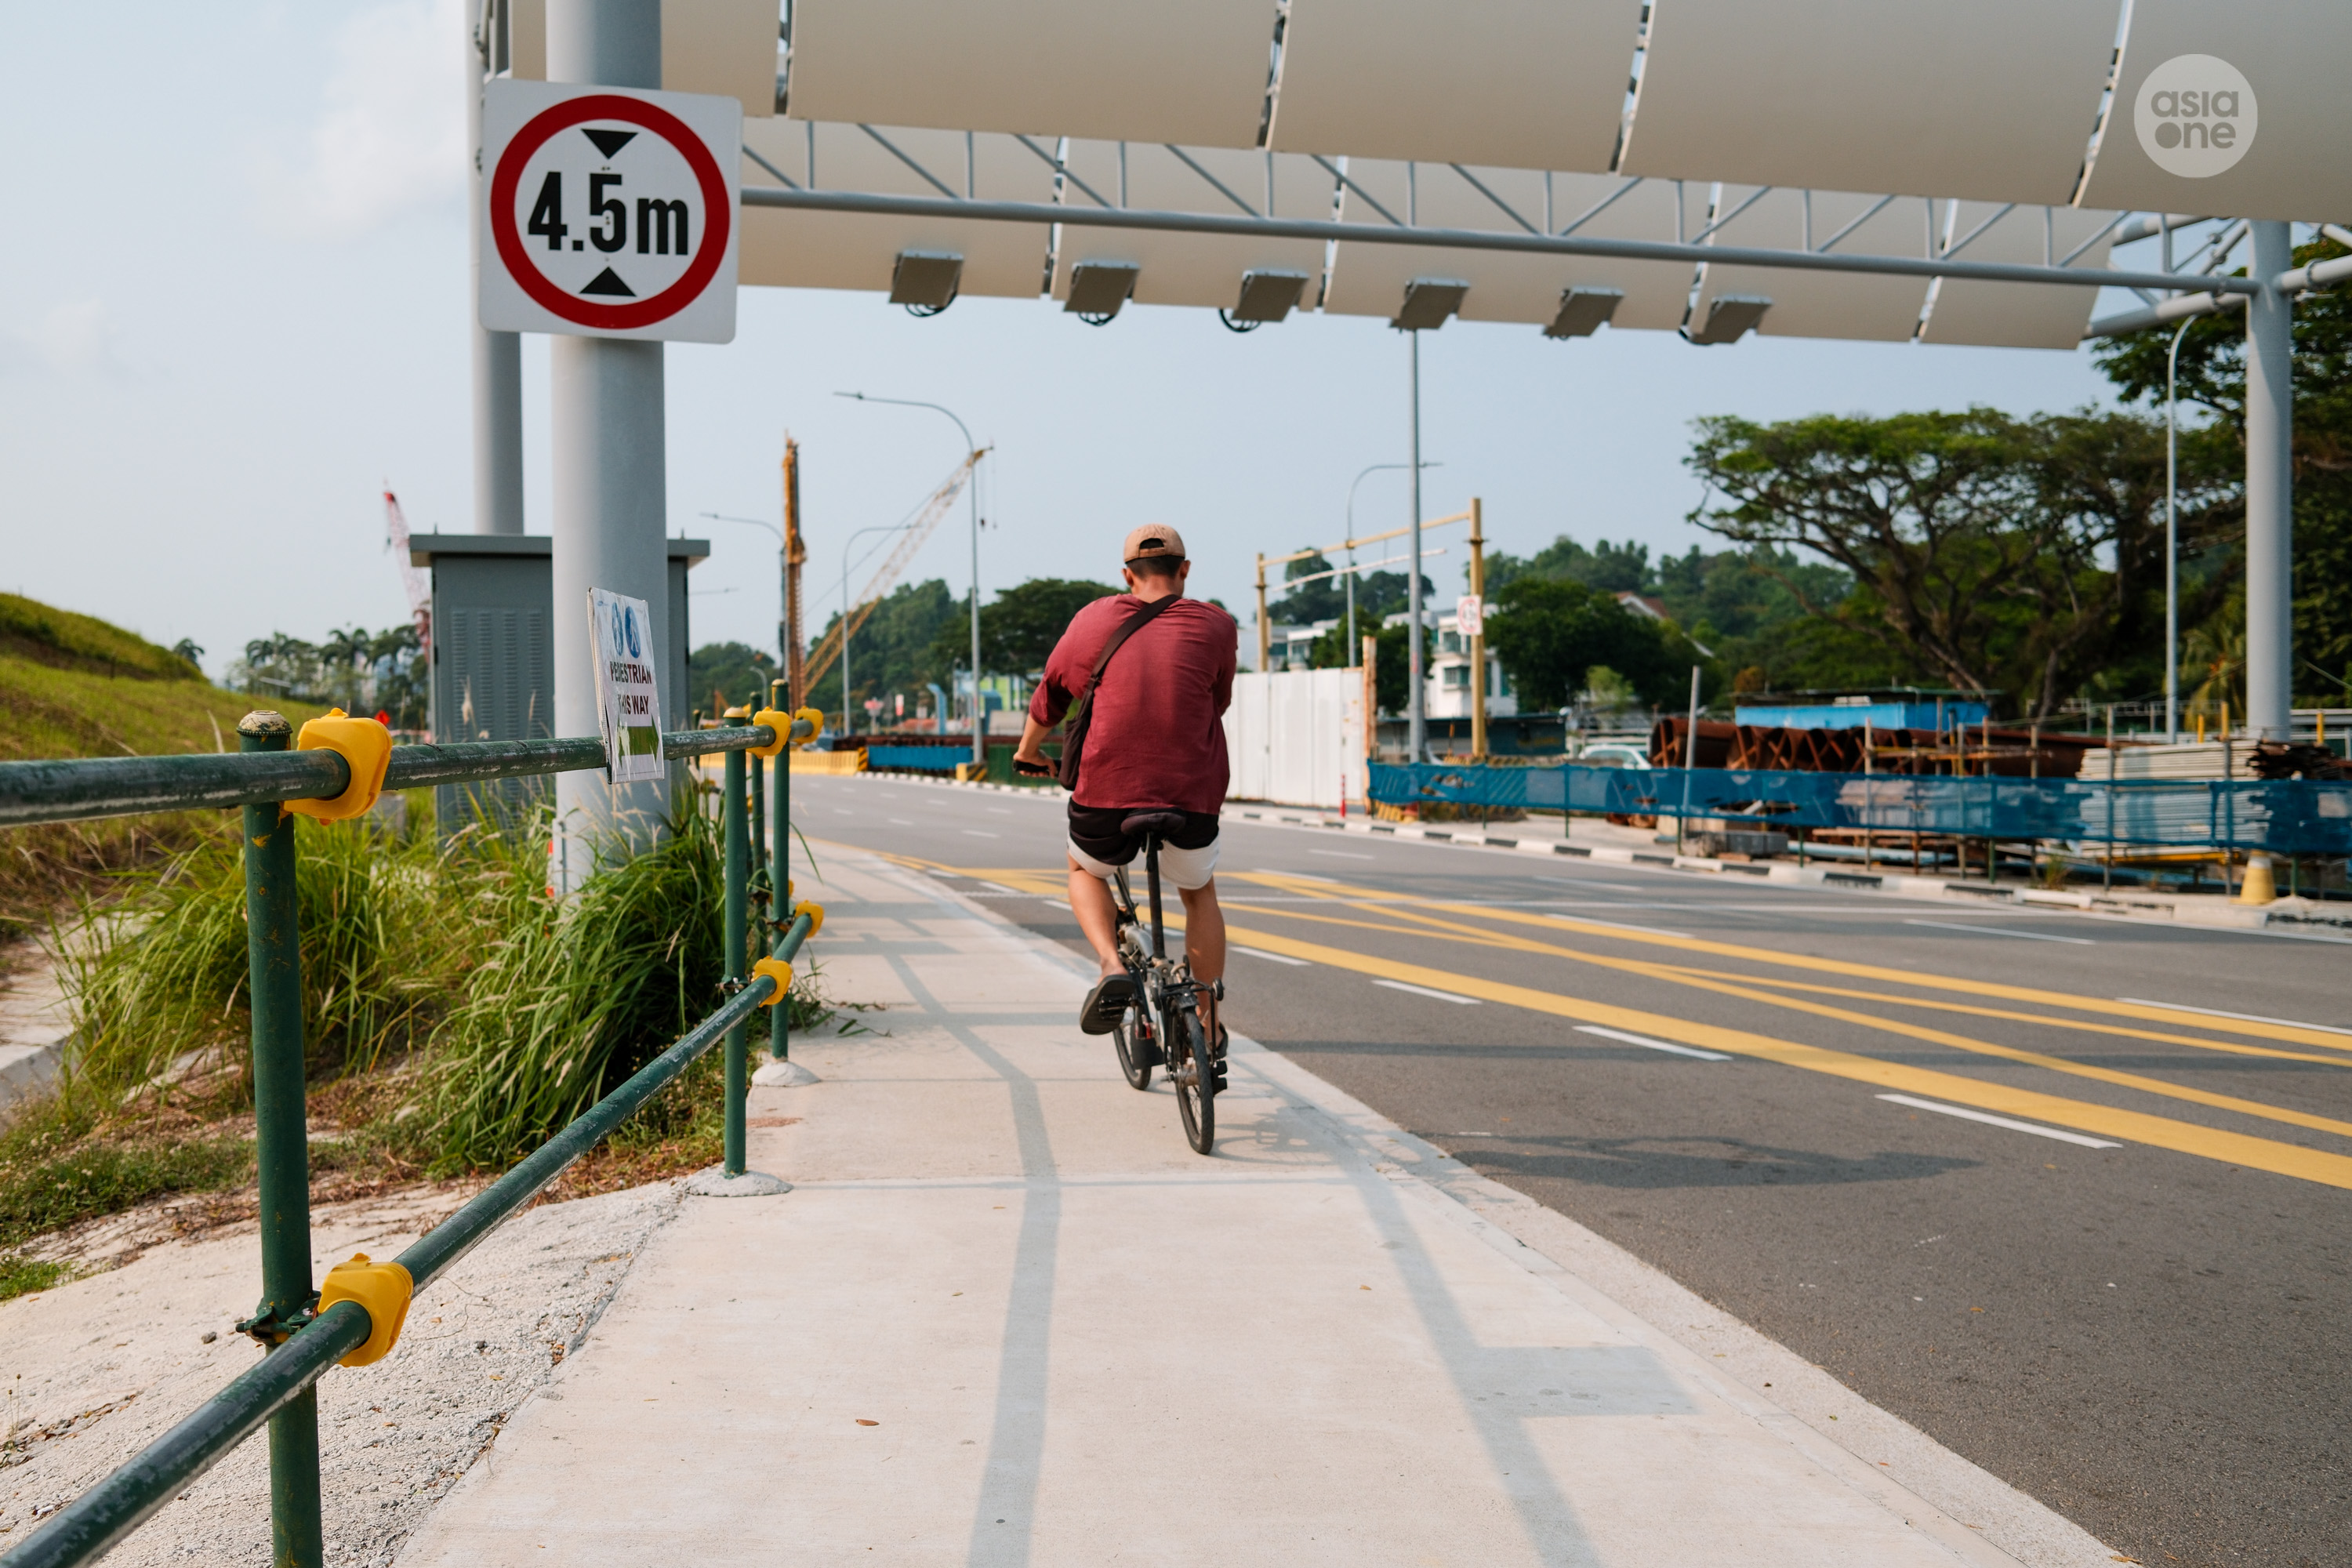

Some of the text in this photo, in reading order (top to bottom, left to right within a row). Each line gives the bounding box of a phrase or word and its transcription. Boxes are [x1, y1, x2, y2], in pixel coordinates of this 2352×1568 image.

[528, 171, 688, 256] 4.5m
[610, 661, 652, 684] PEDESTRIAN
[618, 694, 649, 715] THIS WAY
